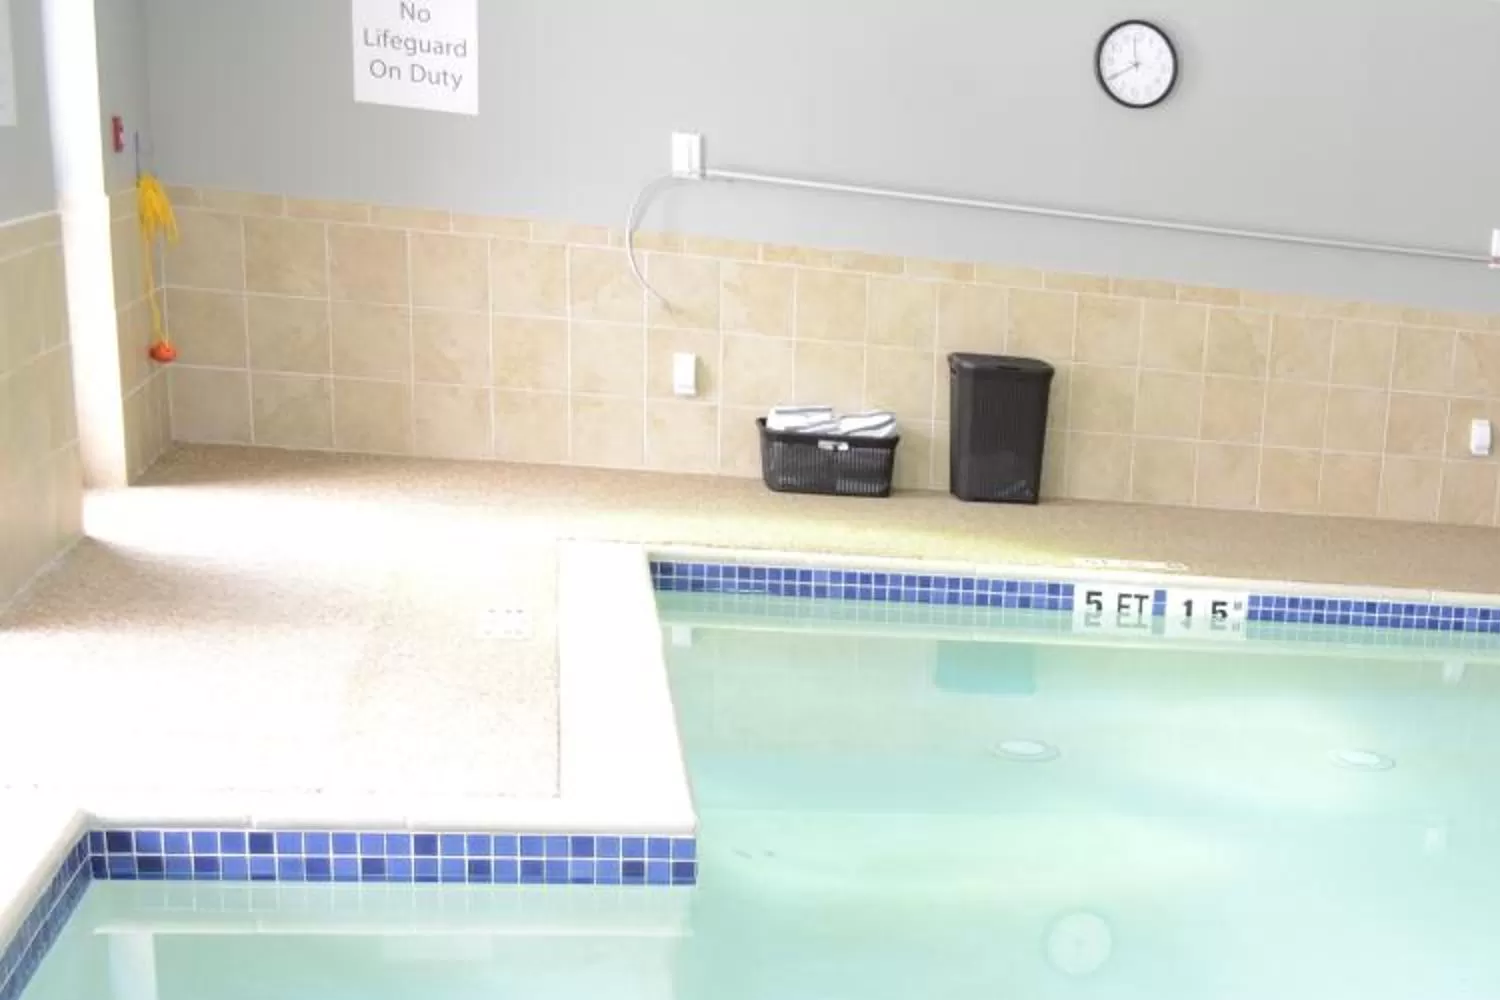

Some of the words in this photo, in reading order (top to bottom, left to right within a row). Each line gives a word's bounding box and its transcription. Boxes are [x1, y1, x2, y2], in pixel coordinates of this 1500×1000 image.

[400, 2, 431, 23] No
[363, 28, 467, 57] Lifeguard
[369, 59, 401, 80] On
[410, 63, 463, 91] Duty
[1116, 592, 1150, 615] FT
